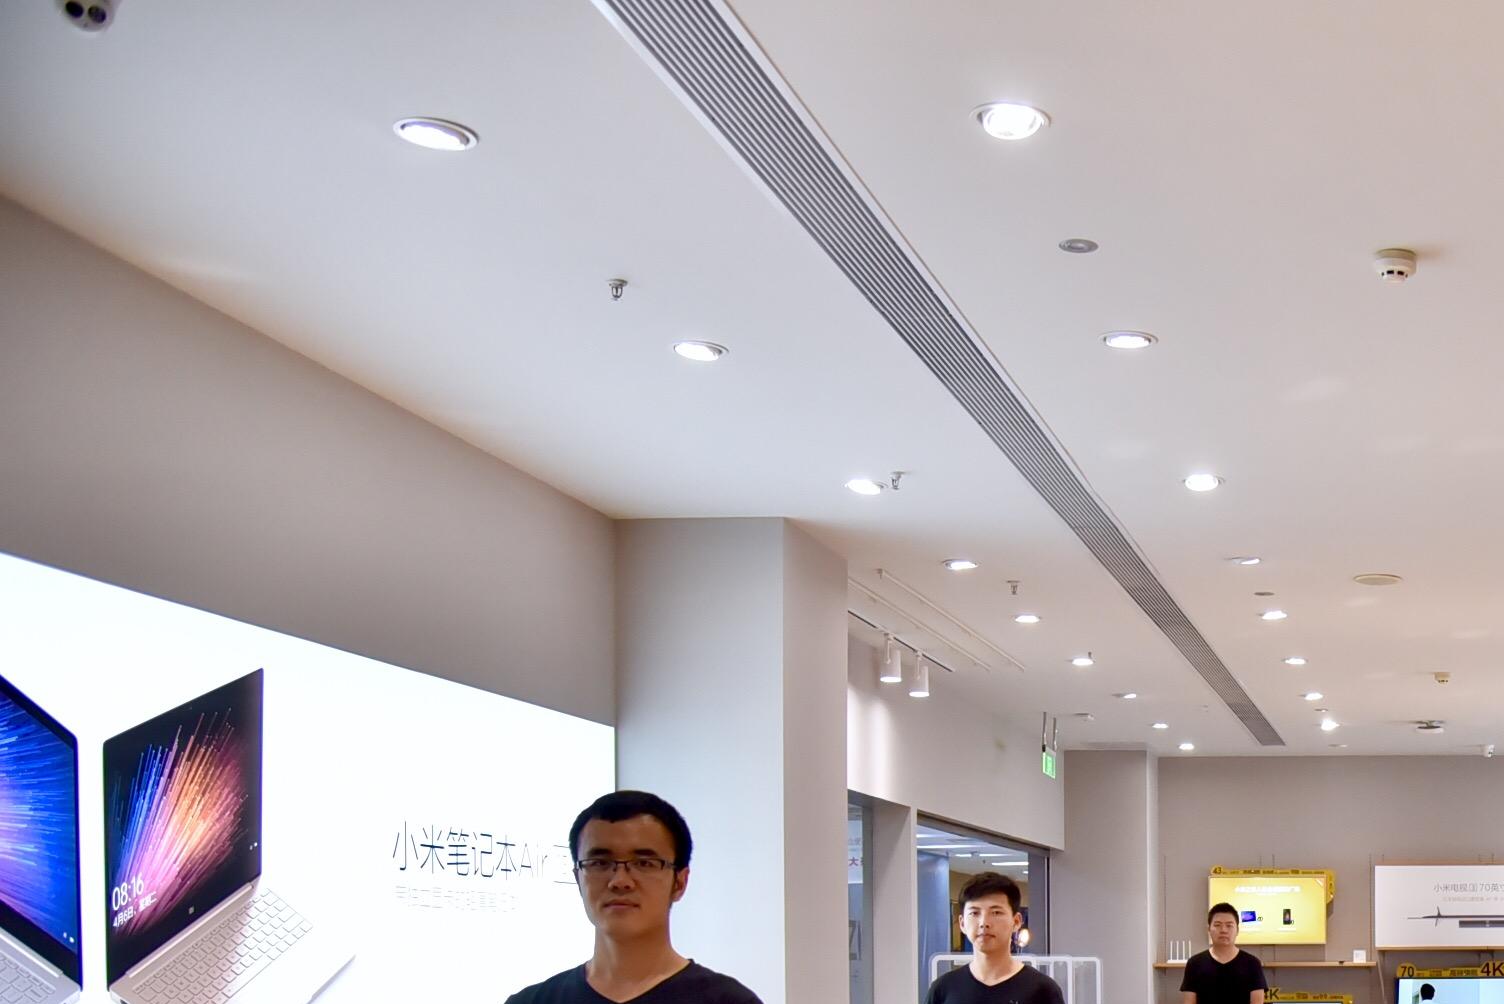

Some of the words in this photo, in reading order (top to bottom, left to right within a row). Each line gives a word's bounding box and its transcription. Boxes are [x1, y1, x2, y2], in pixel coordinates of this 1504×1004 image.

[392, 820, 548, 881] 小米笔记本Air
[112, 872, 145, 911] 08:16
[1400, 966, 1415, 977] 70
[1480, 961, 1504, 977] 4K
